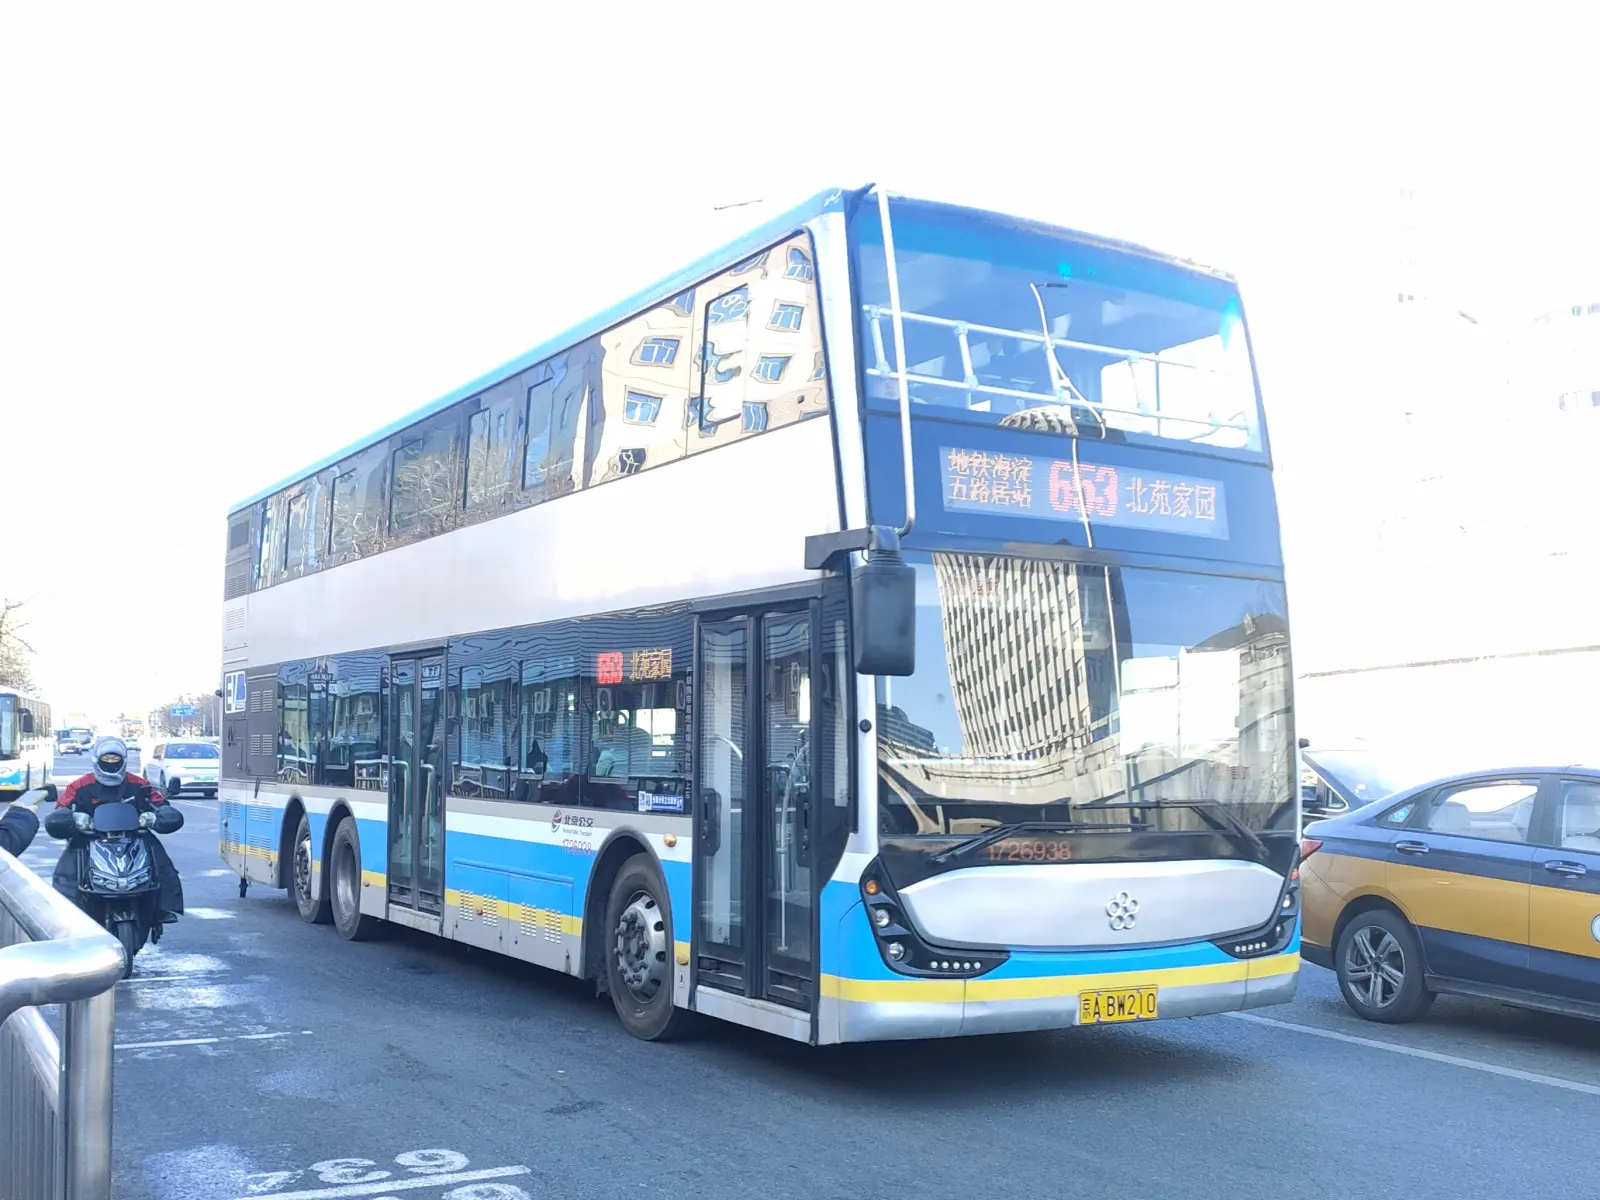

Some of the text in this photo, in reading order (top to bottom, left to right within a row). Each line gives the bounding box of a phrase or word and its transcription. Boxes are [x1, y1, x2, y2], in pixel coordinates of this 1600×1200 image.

[947, 447, 1033, 481] 地铁海淀
[947, 475, 1033, 509] 五路居站
[1048, 460, 1118, 517] 653
[1124, 476, 1216, 521] 北苑家园
[563, 814, 594, 828] 北京公交
[988, 841, 1072, 861] 1726938
